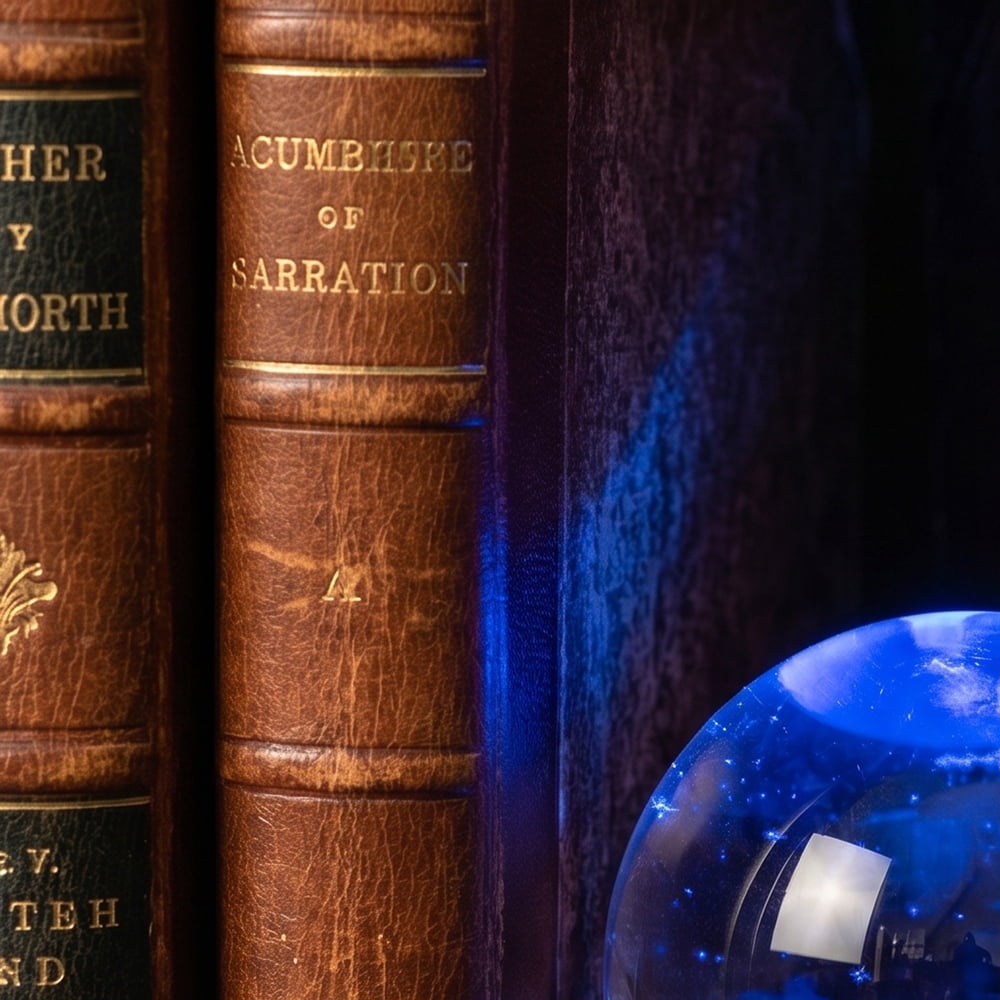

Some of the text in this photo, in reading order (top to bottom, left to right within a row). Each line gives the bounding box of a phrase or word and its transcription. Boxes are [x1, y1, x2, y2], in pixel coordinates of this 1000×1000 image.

[0, 143, 107, 182] HER
[317, 206, 365, 230] OF
[231, 257, 469, 296] SARRATION
